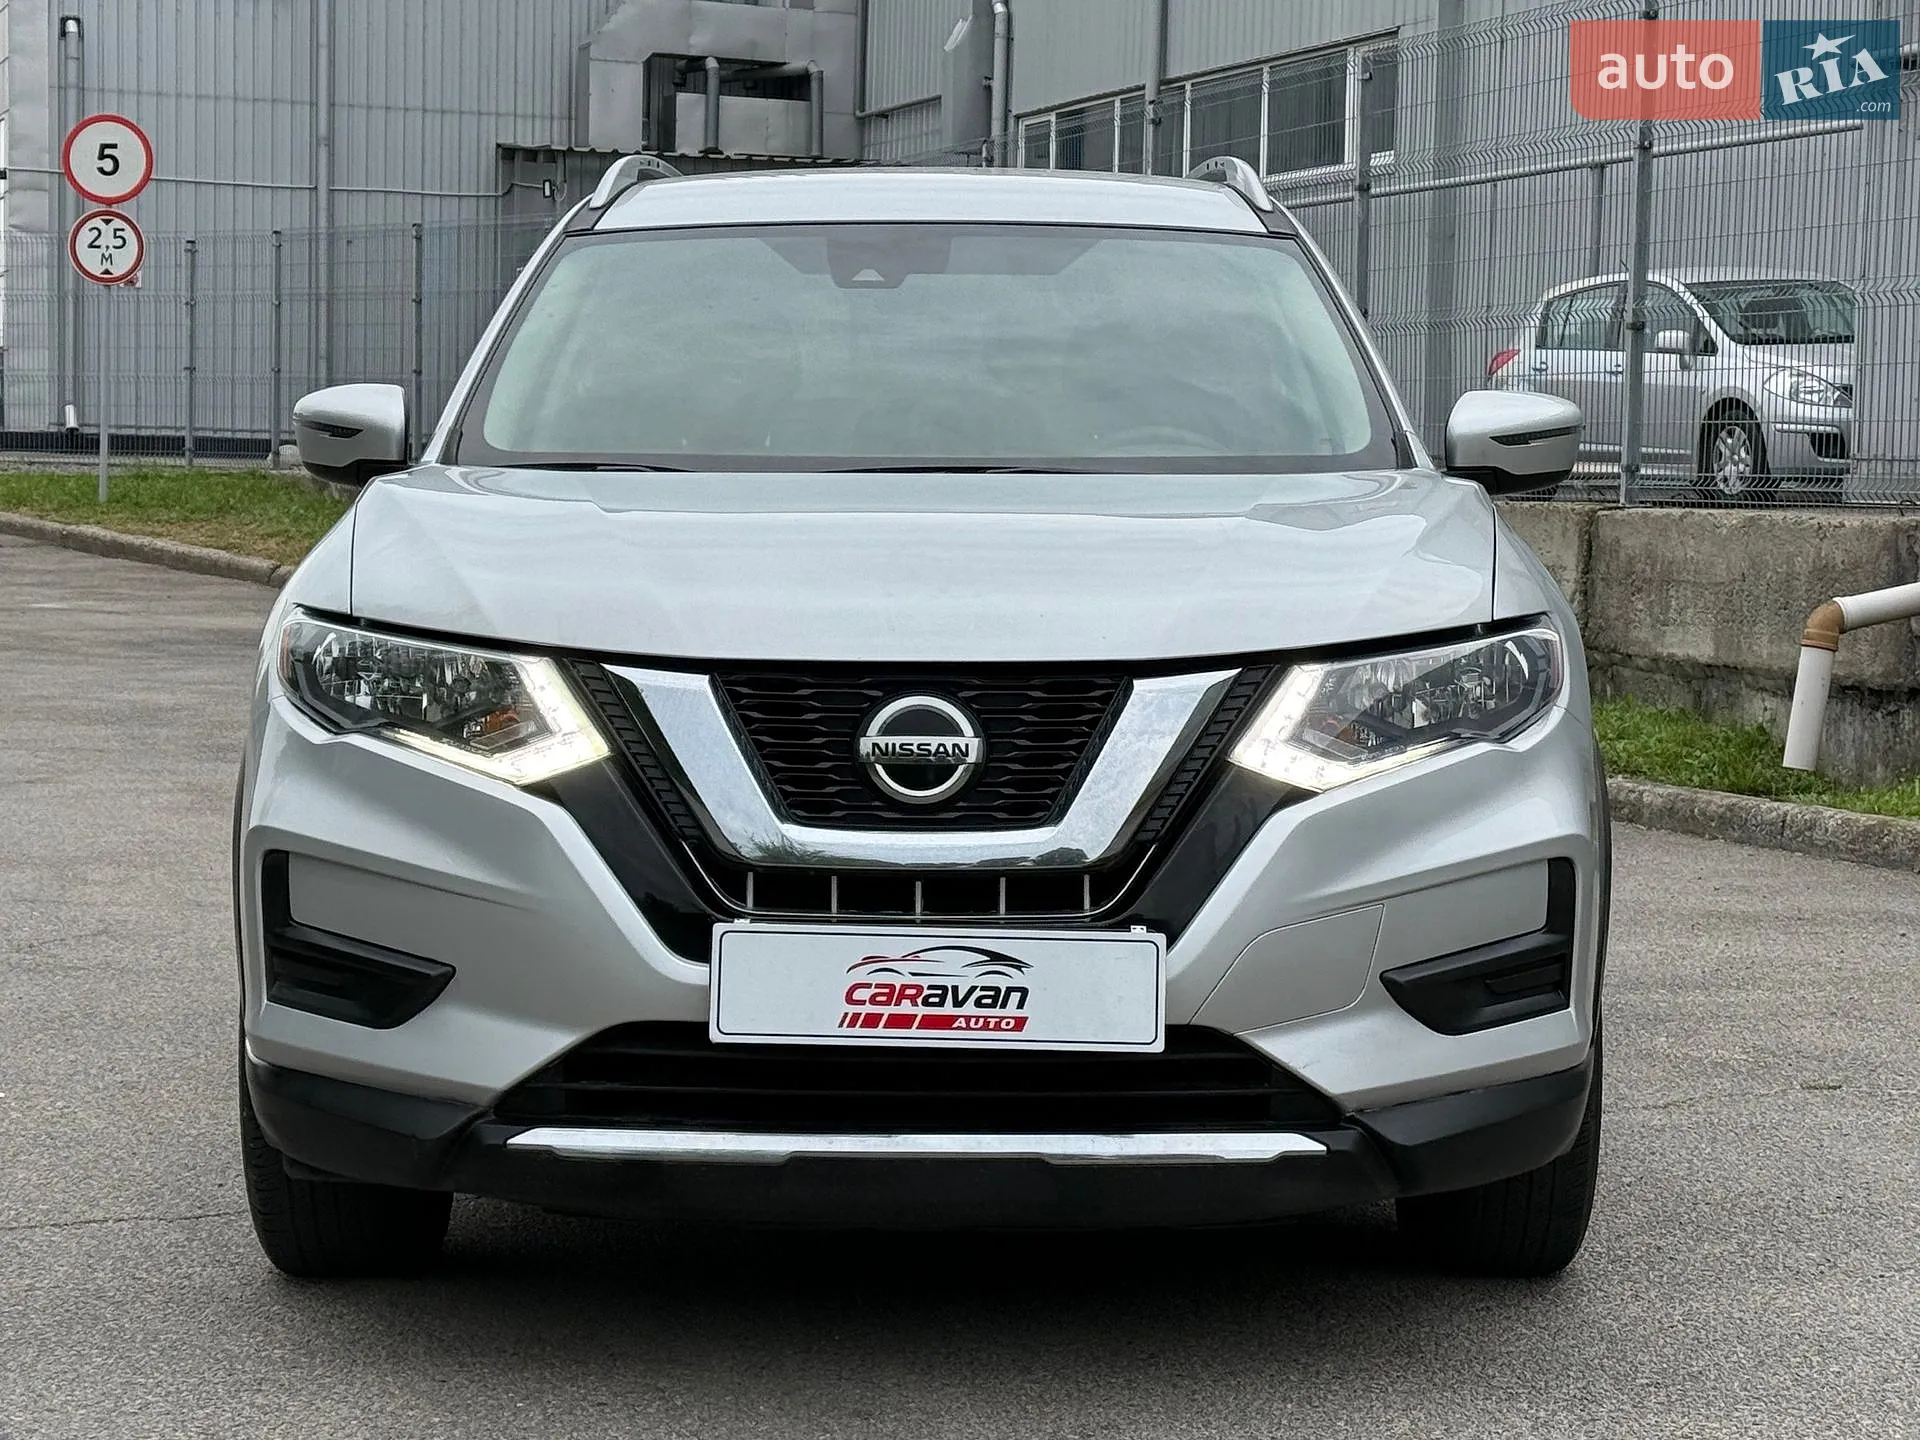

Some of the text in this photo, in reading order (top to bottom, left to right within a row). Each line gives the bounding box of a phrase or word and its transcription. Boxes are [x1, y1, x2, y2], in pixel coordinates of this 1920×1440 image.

[96, 143, 120, 177] 5
[87, 226, 127, 252] 2,5
[871, 742, 970, 758] NISSAN
[951, 1017, 1016, 1030] AUTO
